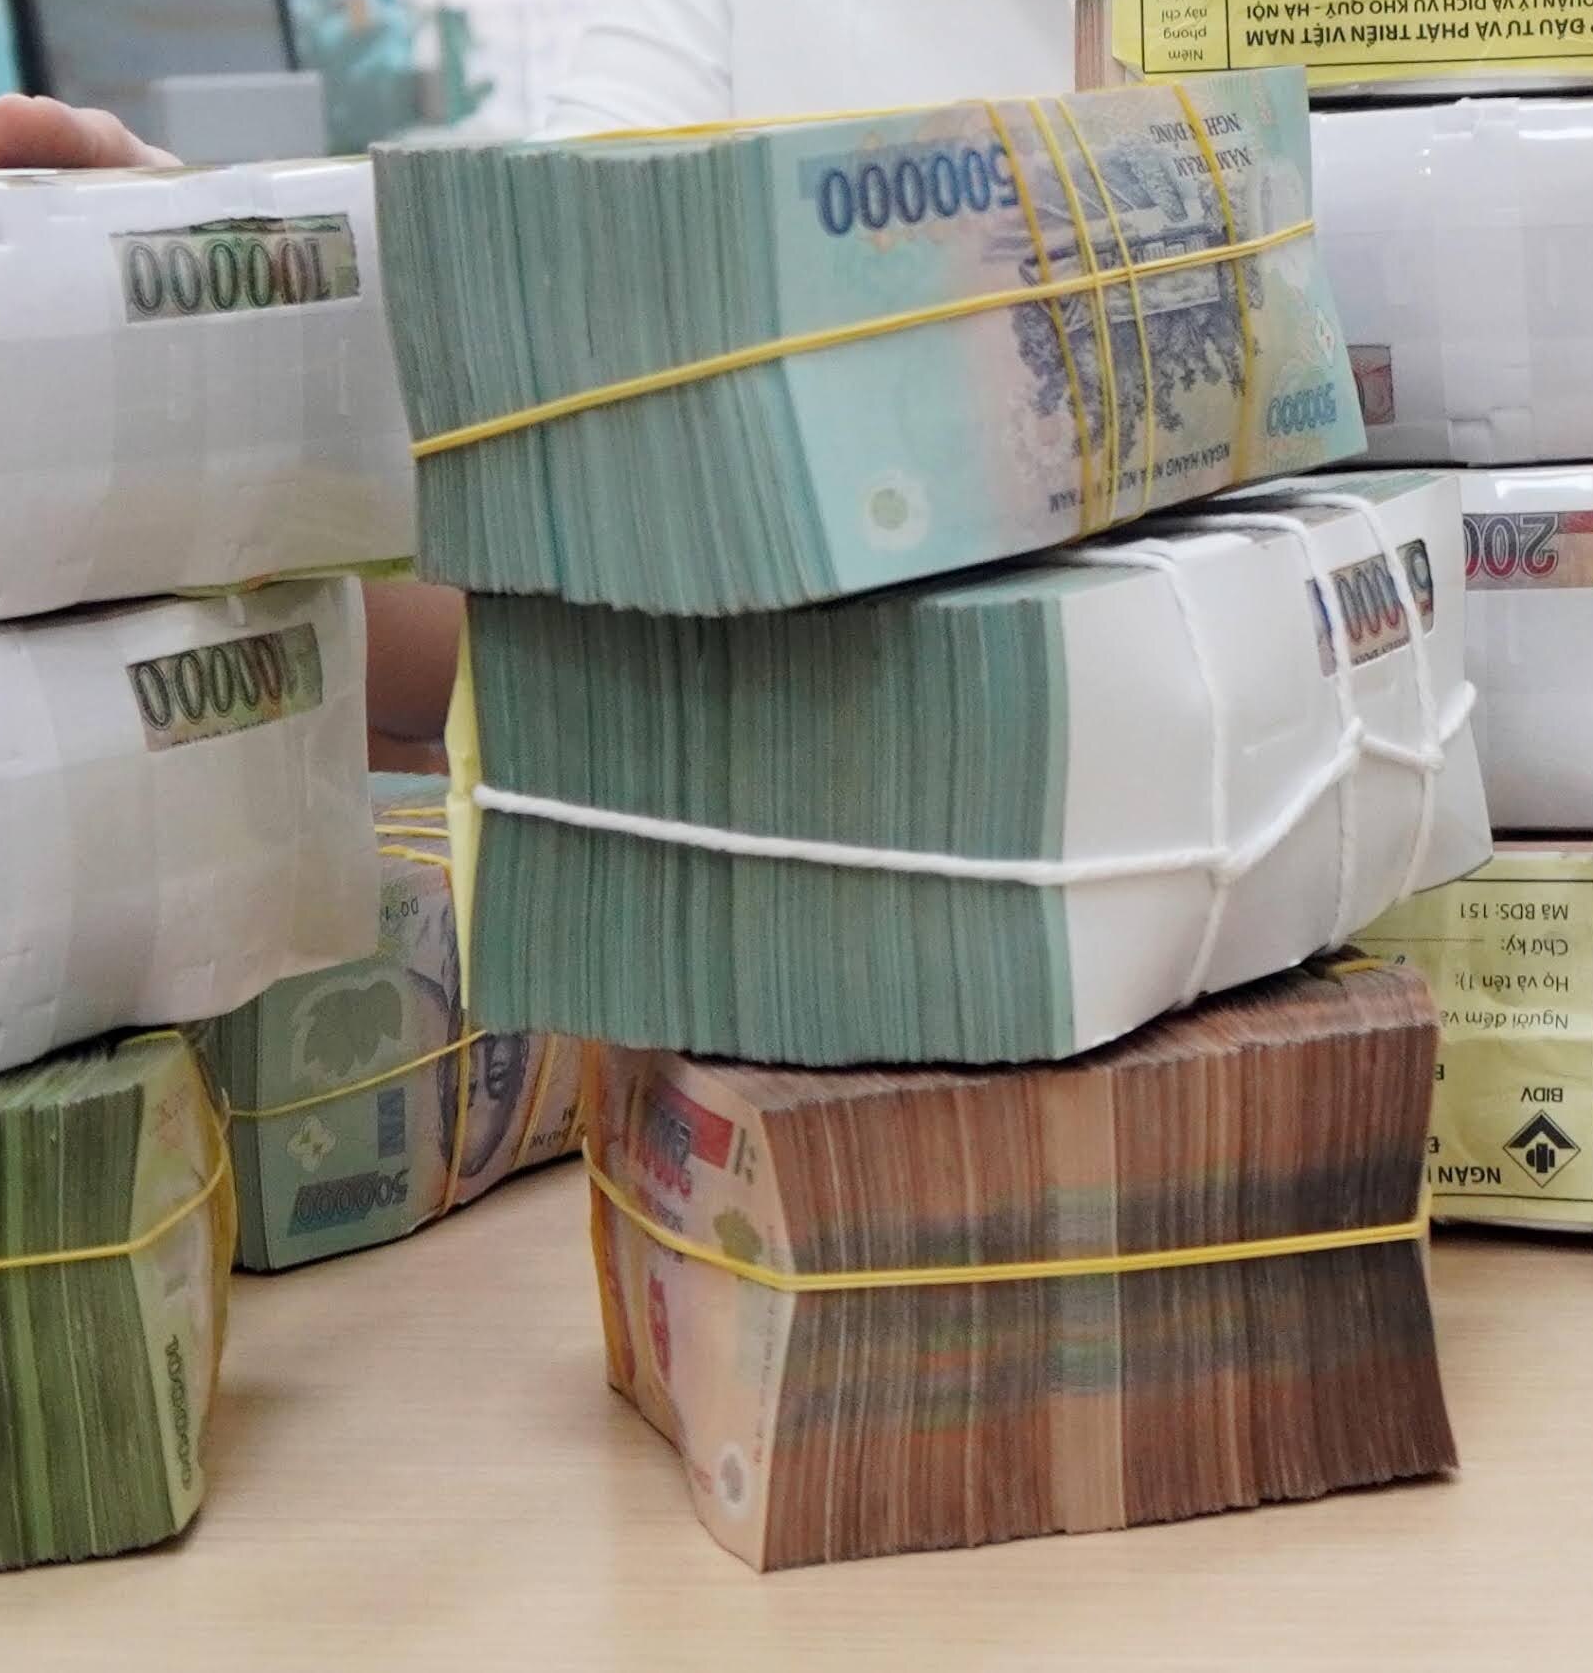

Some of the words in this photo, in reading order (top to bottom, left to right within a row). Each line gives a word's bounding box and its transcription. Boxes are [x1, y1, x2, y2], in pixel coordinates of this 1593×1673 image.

[1184, 6, 1207, 20] này
[1247, 1, 1279, 22] NỘI
[1284, 3, 1309, 21] HÀ
[1163, 25, 1207, 41] phong
[1245, 28, 1294, 47] NAM
[1300, 23, 1345, 47] VIỆT
[1351, 24, 1410, 48] TRIỂN
[1417, 22, 1469, 44] PHÁT
[1476, 21, 1501, 43] VÀ
[1504, 20, 1534, 40] TƯ
[1539, 18, 1585, 41] ĐẦU
[1168, 49, 1204, 61] Niêm
[817, 144, 1018, 238] 500000
[1459, 903, 1488, 919] 151
[1495, 903, 1536, 920] BDS:
[1542, 903, 1569, 921] Mã
[1500, 934, 1526, 956] ký:
[1531, 938, 1569, 956] Chữ
[1482, 975, 1511, 992] tên
[1517, 975, 1537, 992] và
[1543, 973, 1569, 992] Họ
[1465, 1011, 1507, 1031] đếm
[1512, 1009, 1569, 1030] Người
[1520, 1087, 1563, 1103] BIDV
[1438, 1166, 1501, 1187] NGÂN
